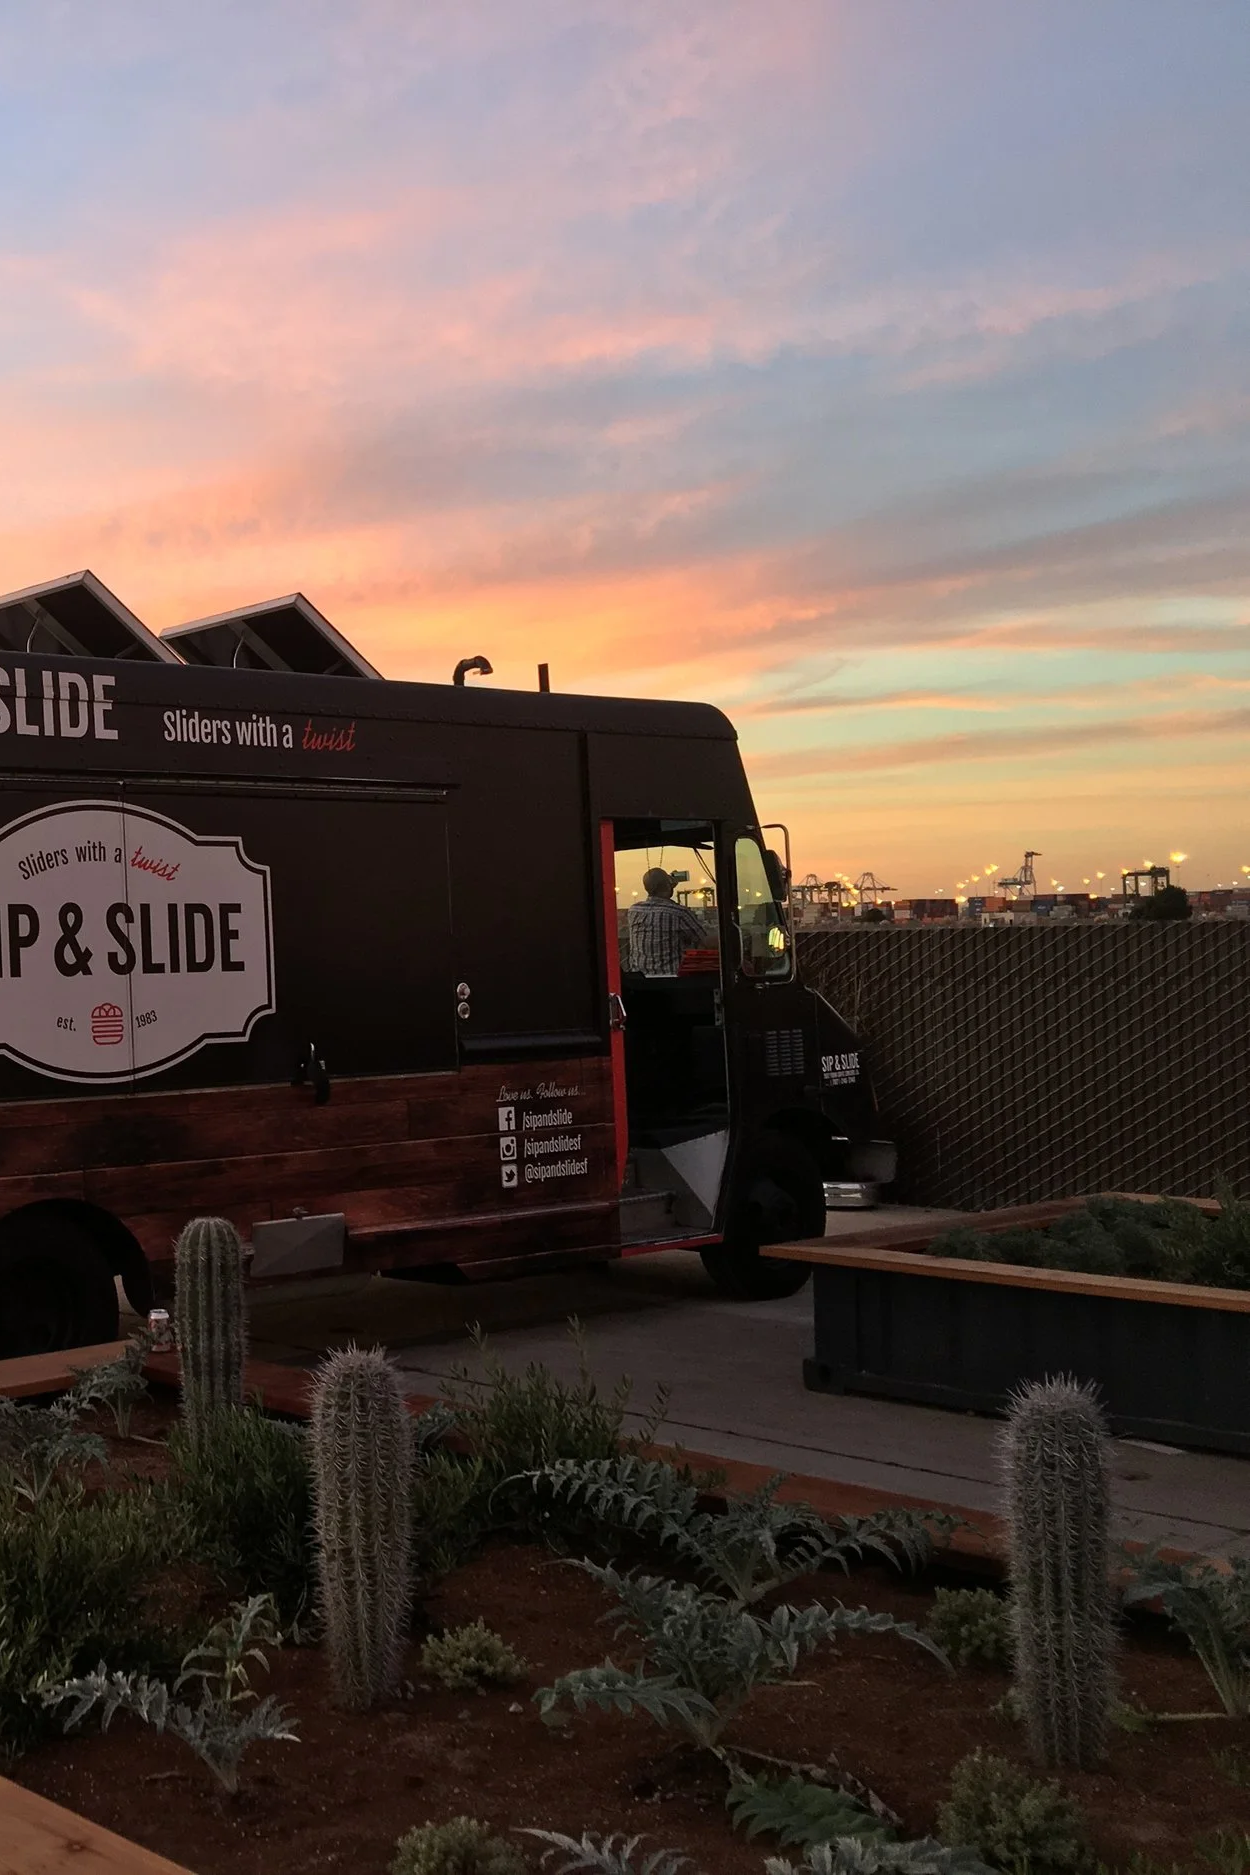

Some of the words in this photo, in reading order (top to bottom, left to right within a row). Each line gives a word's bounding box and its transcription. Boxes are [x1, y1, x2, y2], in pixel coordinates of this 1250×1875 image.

[163, 710, 231, 745] Sliders
[235, 714, 278, 748] with
[281, 722, 293, 748] a
[301, 718, 356, 751] twist
[18, 847, 69, 881] Sliders
[75, 840, 107, 863] with
[114, 846, 123, 864] a
[130, 845, 180, 882] twist
[53, 902, 94, 978] &
[105, 902, 246, 976] SLIDE
[56, 1015, 78, 1033] est.
[135, 1009, 159, 1030] 1983
[821, 1056, 834, 1072] SIP
[834, 1055, 841, 1070] &
[840, 1053, 860, 1070] SLIDE
[496, 1085, 519, 1102] Love
[536, 1082, 566, 1099] Follow
[522, 1109, 573, 1131] /sipandslide
[524, 1134, 581, 1158] /sipandslidesf
[524, 1158, 588, 1183] @sipandslidesf
